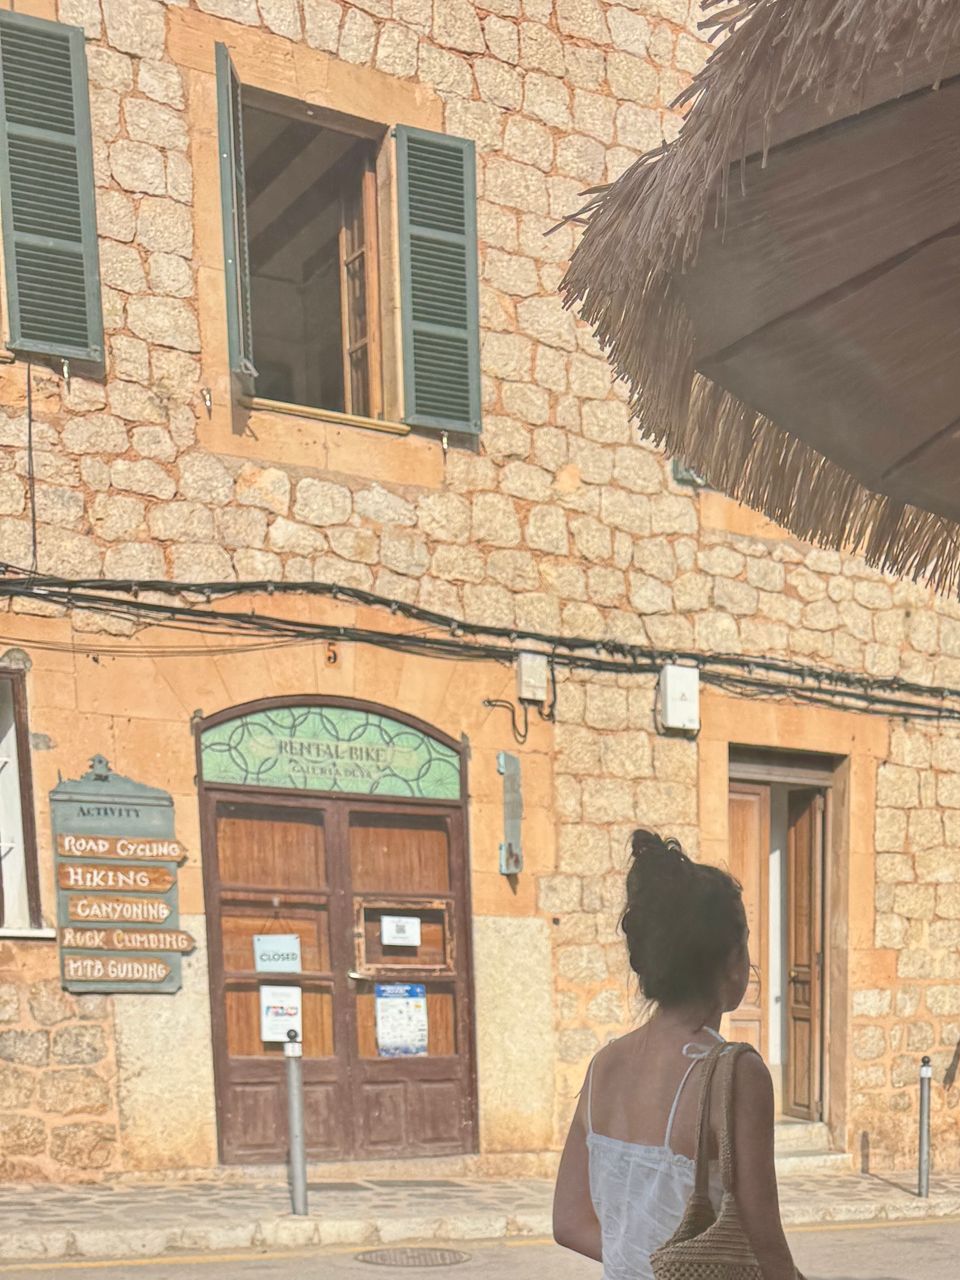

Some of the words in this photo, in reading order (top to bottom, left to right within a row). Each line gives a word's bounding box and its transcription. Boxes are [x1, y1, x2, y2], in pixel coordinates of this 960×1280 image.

[327, 642, 337, 664] 5
[278, 739, 345, 760] RENTAL
[349, 746, 388, 764] BIKE
[64, 836, 110, 856] ROAD
[116, 839, 181, 857] CYCLING
[259, 952, 298, 962] CLOSED
[69, 959, 105, 979] MTB
[108, 960, 167, 979] GUIDING
